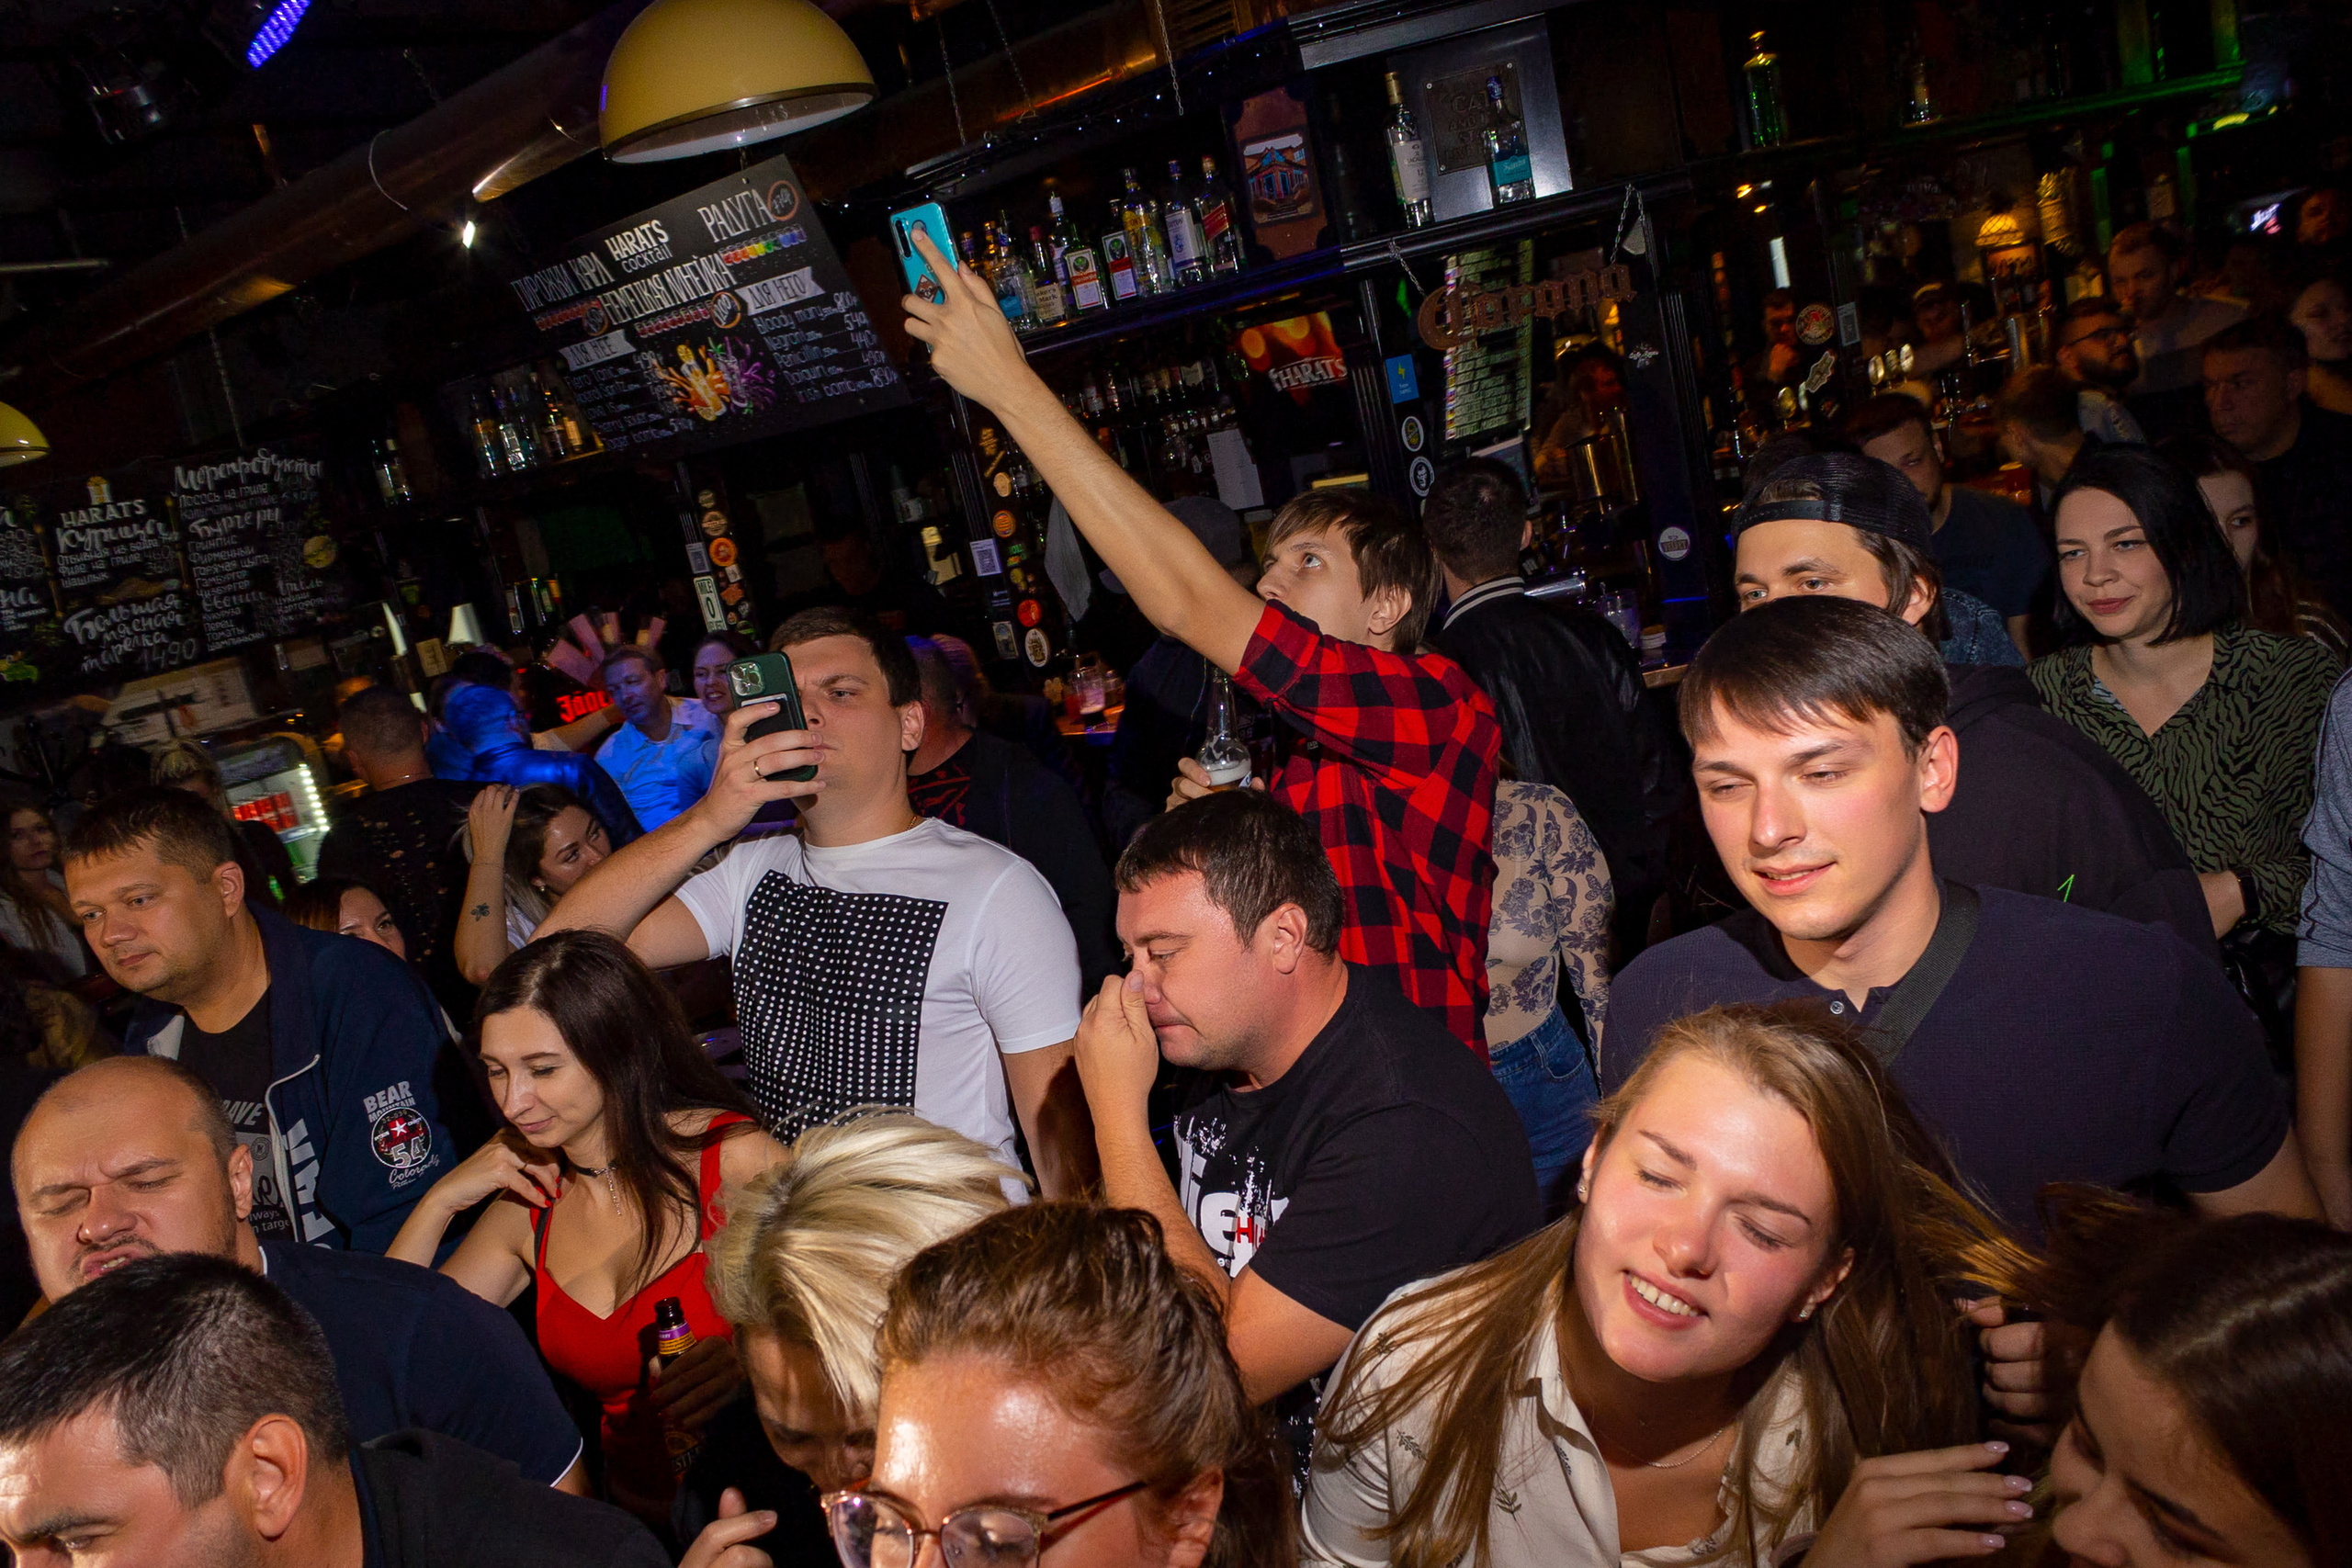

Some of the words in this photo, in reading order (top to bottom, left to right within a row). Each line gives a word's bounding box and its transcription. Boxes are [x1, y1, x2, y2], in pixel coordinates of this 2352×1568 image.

[697, 189, 776, 243] РАДУГА
[604, 220, 670, 261] HARATS
[620, 243, 673, 274] cocktail
[773, 275, 807, 301] НЕГО
[1277, 358, 1348, 389] HARATS
[60, 499, 148, 529] HARATS
[223, 1099, 263, 1126] AVE
[363, 1080, 413, 1114] BEAR
[390, 1135, 427, 1168] 54
[249, 1209, 280, 1223] lways
[262, 1220, 290, 1233] targe
